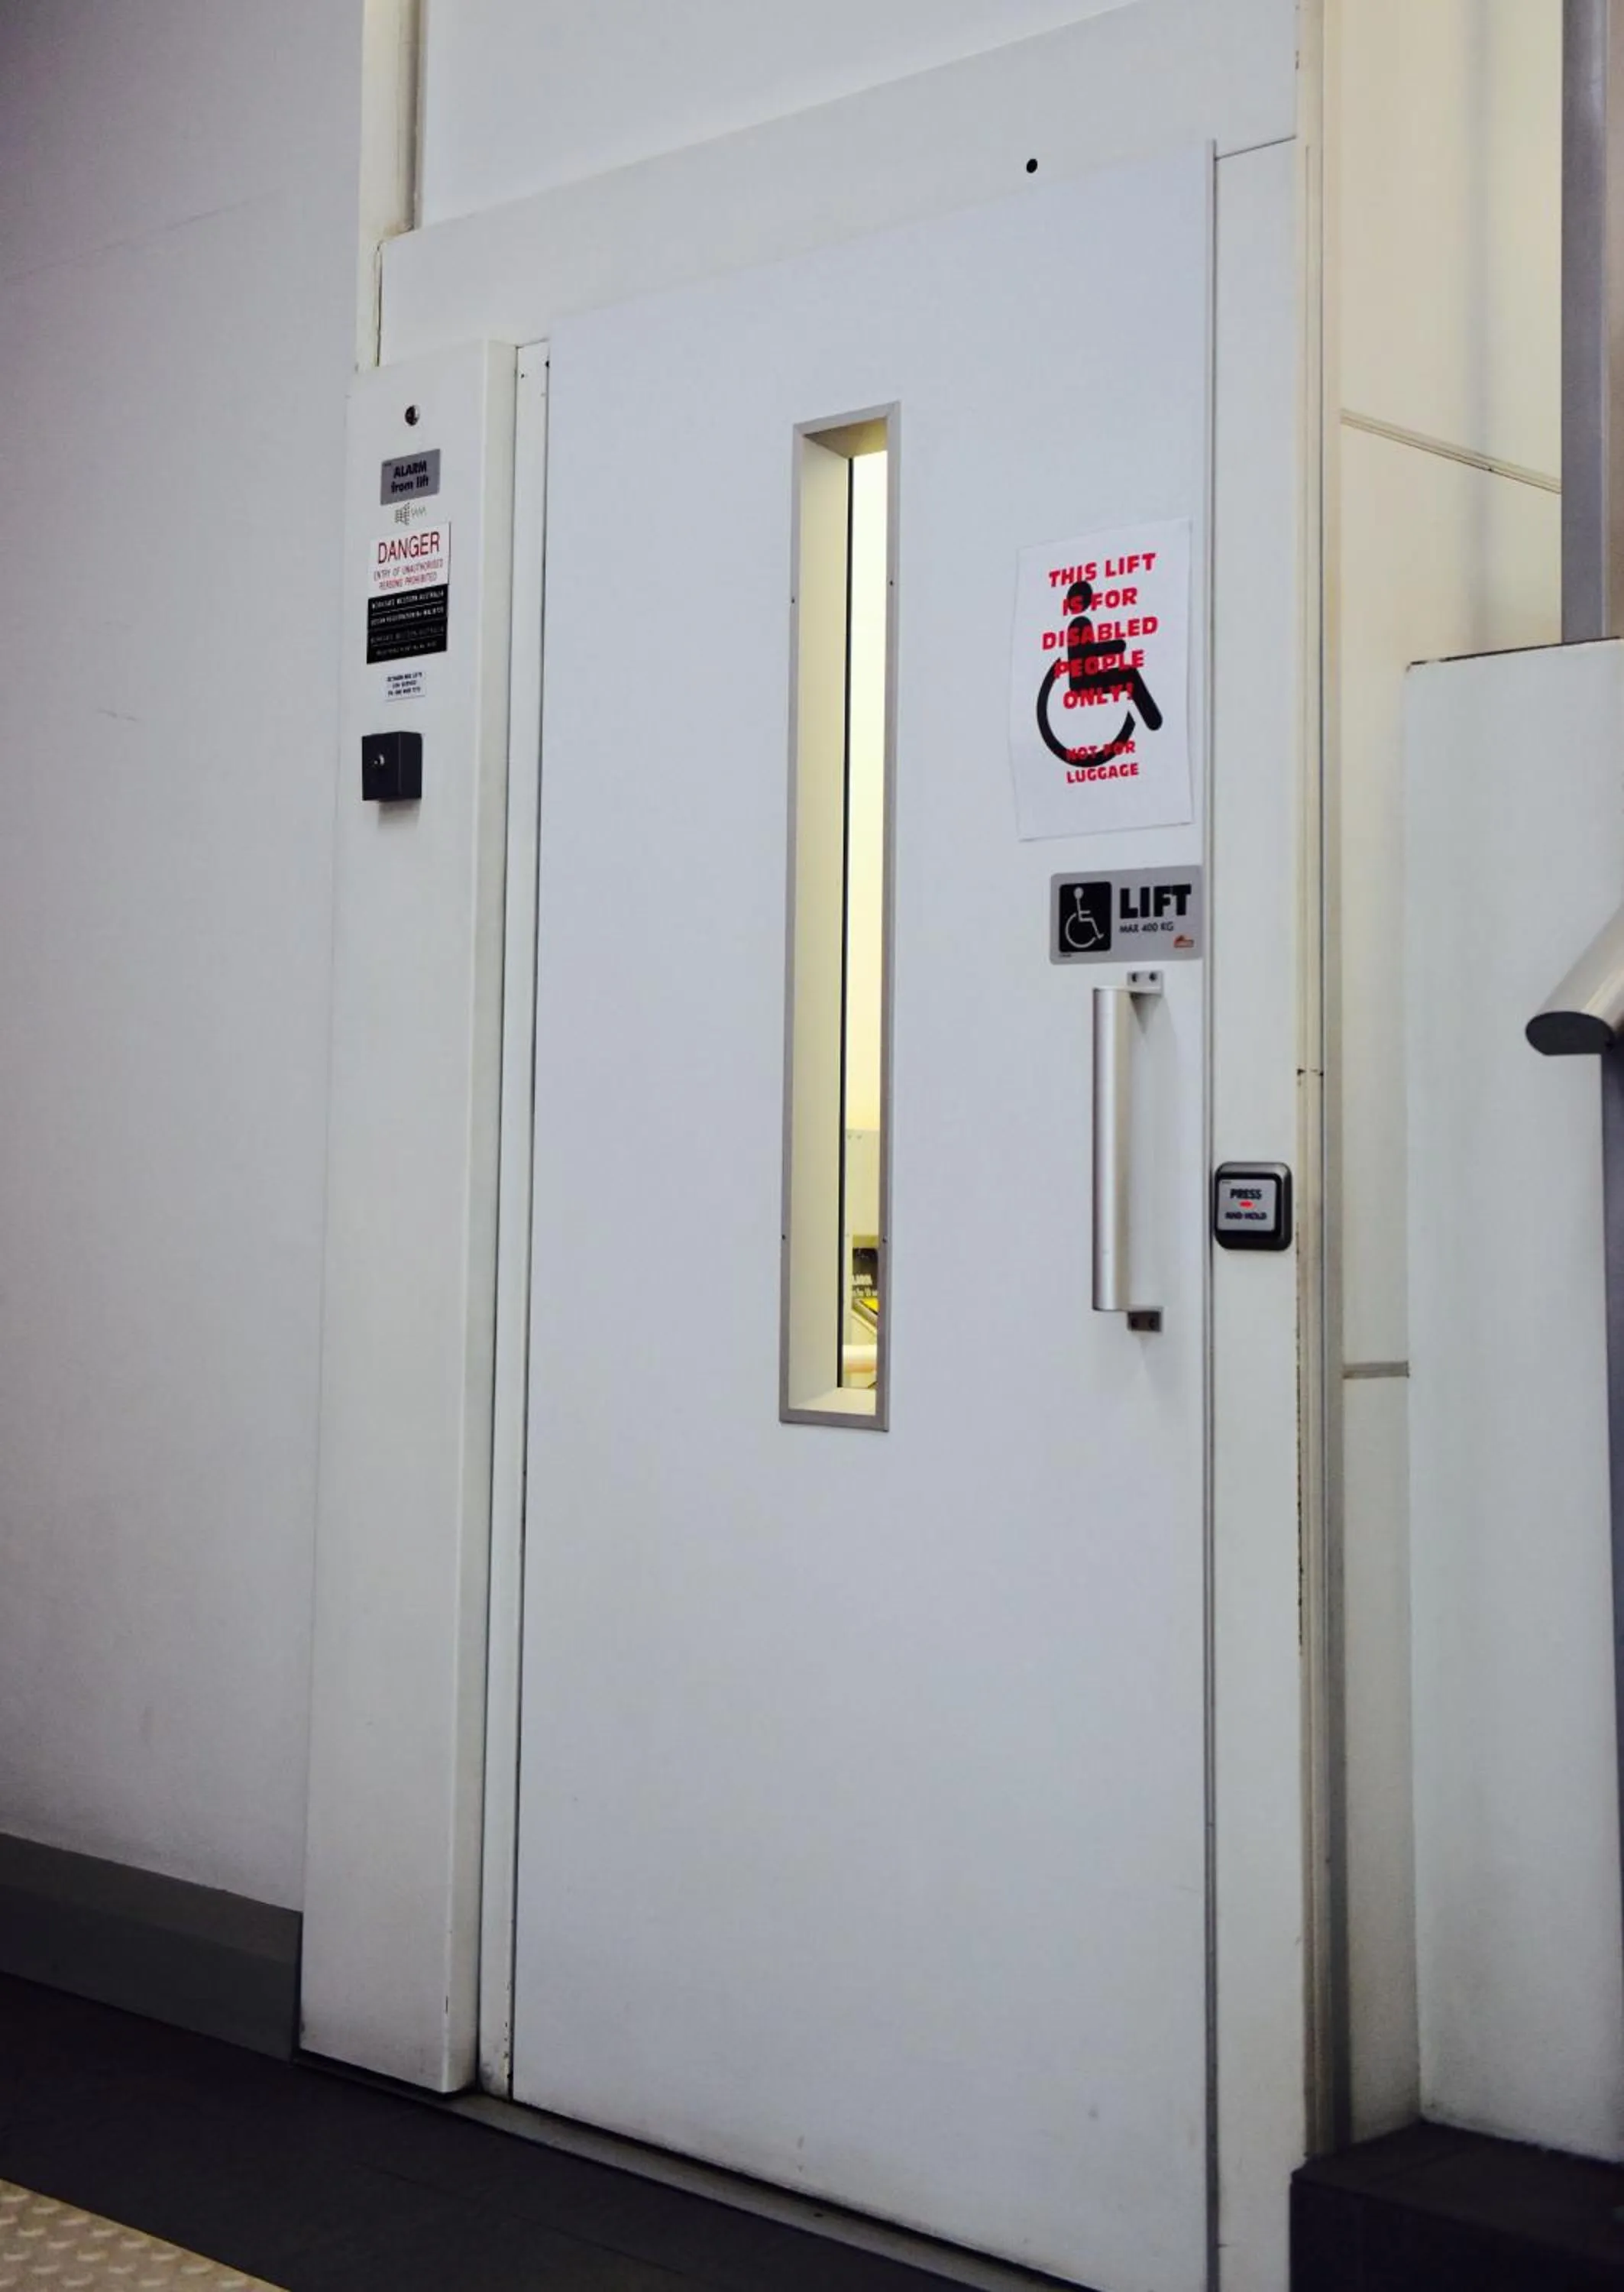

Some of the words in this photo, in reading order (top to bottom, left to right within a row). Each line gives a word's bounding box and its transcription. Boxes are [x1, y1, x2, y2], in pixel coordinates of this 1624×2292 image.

[393, 460, 427, 478] ALARM
[391, 481, 413, 494] from
[416, 474, 429, 488] lift
[378, 531, 441, 564] DANGER
[1049, 562, 1097, 588] THIS
[1105, 552, 1157, 578] LIFT
[1063, 594, 1083, 617] IS
[1091, 587, 1137, 610] FOR
[1042, 616, 1158, 650] DISABLED
[1053, 649, 1144, 678] PEOPLE
[1063, 682, 1134, 710] ONLY!
[1066, 743, 1097, 762] NOT
[1102, 740, 1136, 757] FOR
[1066, 762, 1139, 784] LUGGAGE
[1120, 884, 1192, 919] LIFT
[1120, 923, 1139, 933] MAX
[1142, 921, 1159, 932] 400
[1160, 921, 1174, 931] KG
[1230, 1188, 1262, 1200] PRESS
[1225, 1212, 1243, 1220] AND
[1244, 1212, 1267, 1220] HOLD
